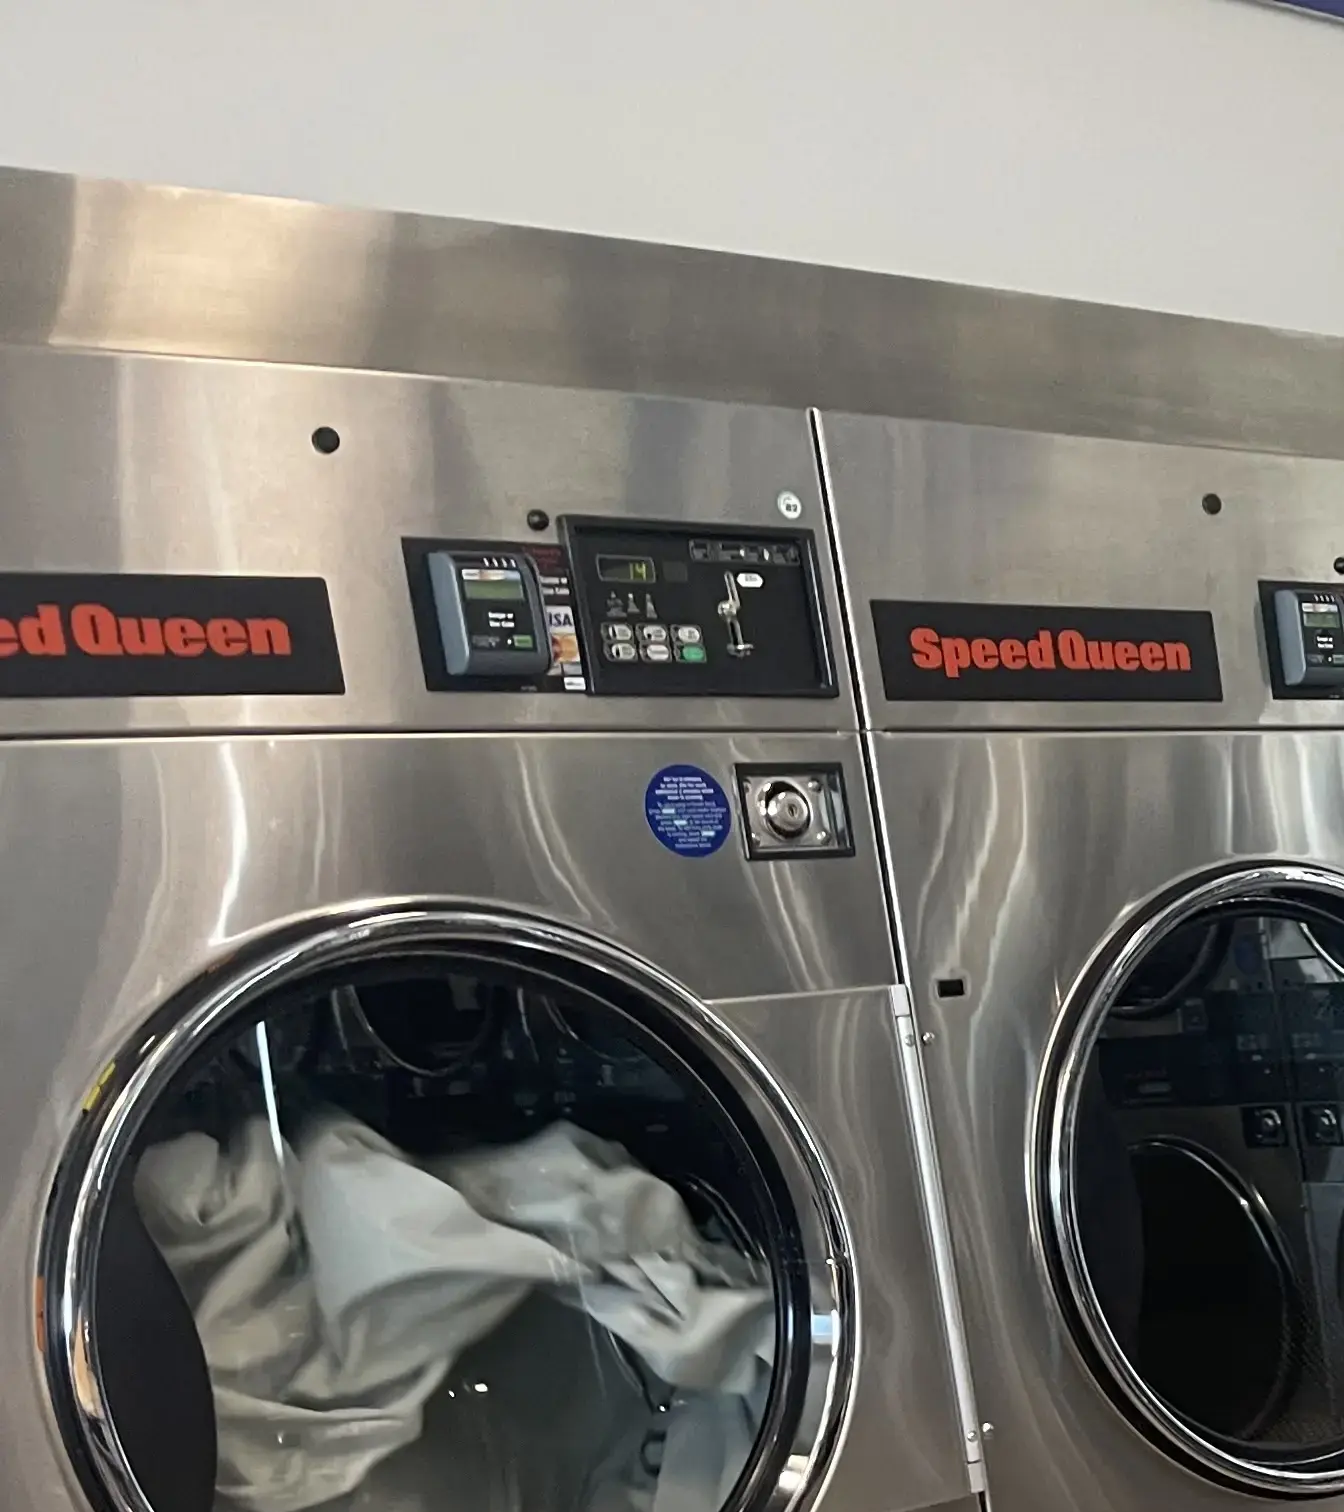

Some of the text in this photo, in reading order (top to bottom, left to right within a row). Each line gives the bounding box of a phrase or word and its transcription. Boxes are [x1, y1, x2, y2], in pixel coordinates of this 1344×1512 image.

[70, 603, 291, 657] Queen
[910, 627, 1192, 678] Speed Queen
